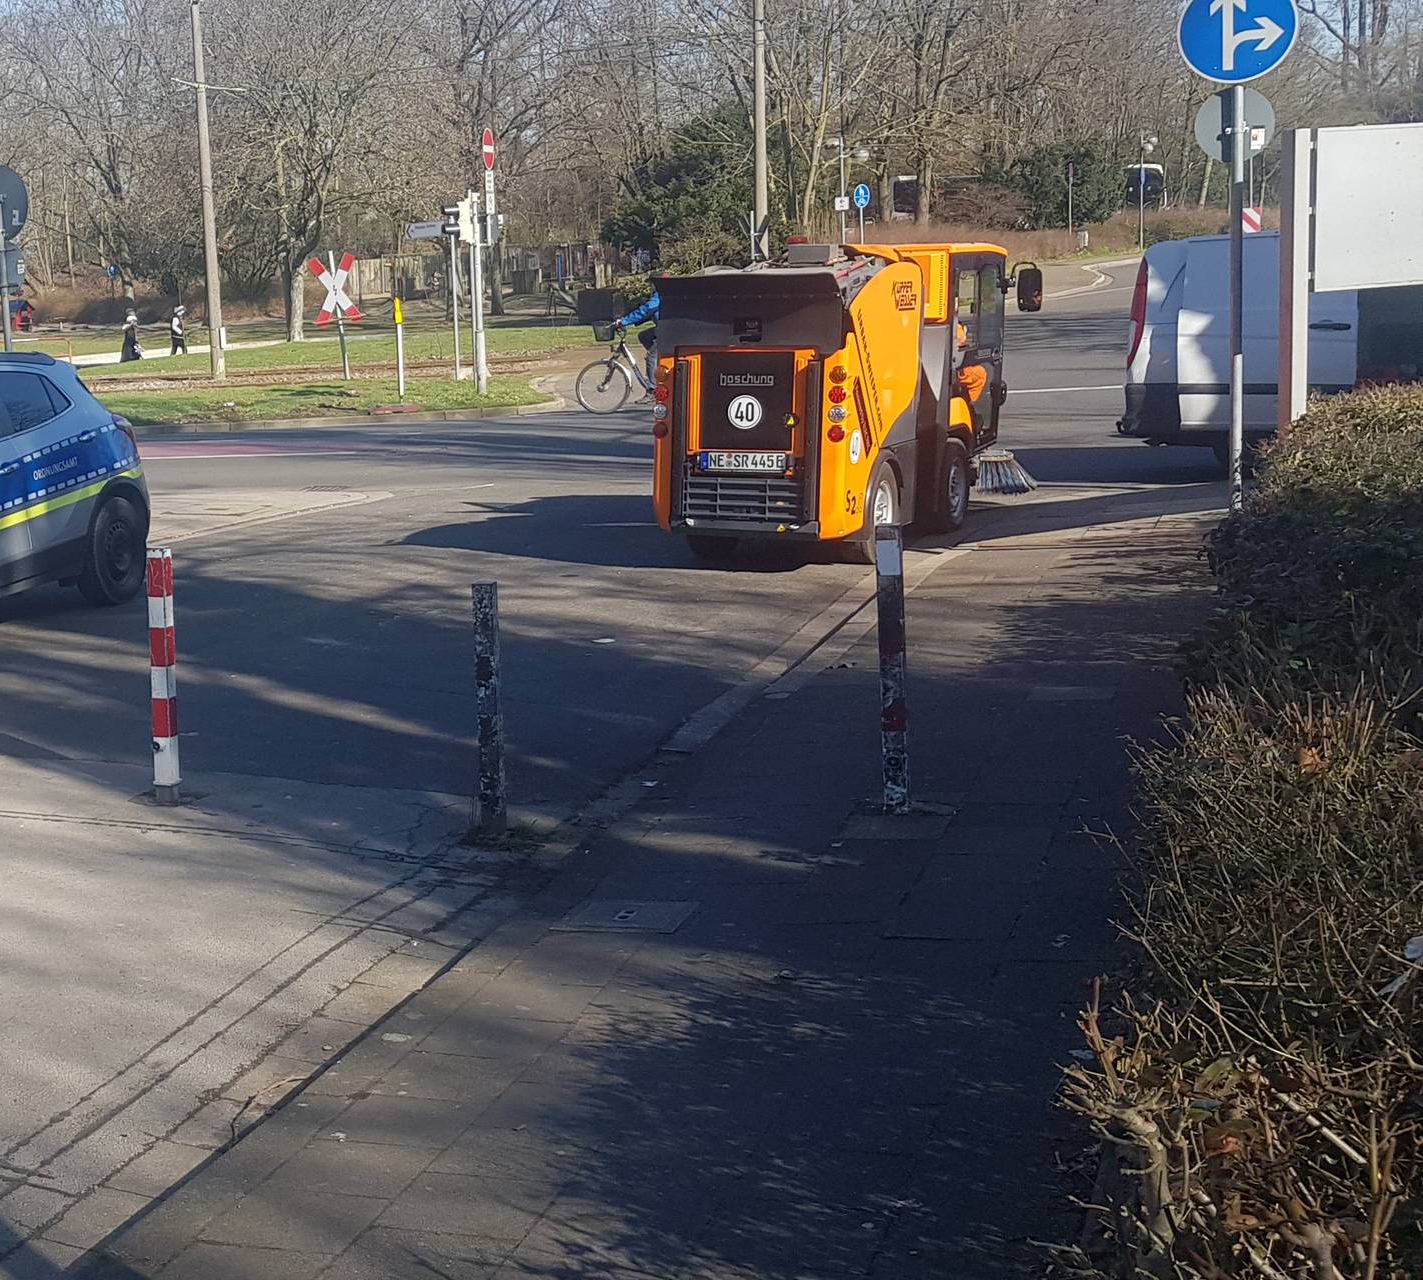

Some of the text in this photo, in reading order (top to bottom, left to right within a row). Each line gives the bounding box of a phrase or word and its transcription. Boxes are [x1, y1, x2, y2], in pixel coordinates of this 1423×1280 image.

[720, 373, 774, 387] boschung
[734, 402, 755, 422] 40
[33, 456, 78, 481] ORDNUNGSAMT
[709, 454, 724, 468] NE
[733, 455, 749, 468] SR
